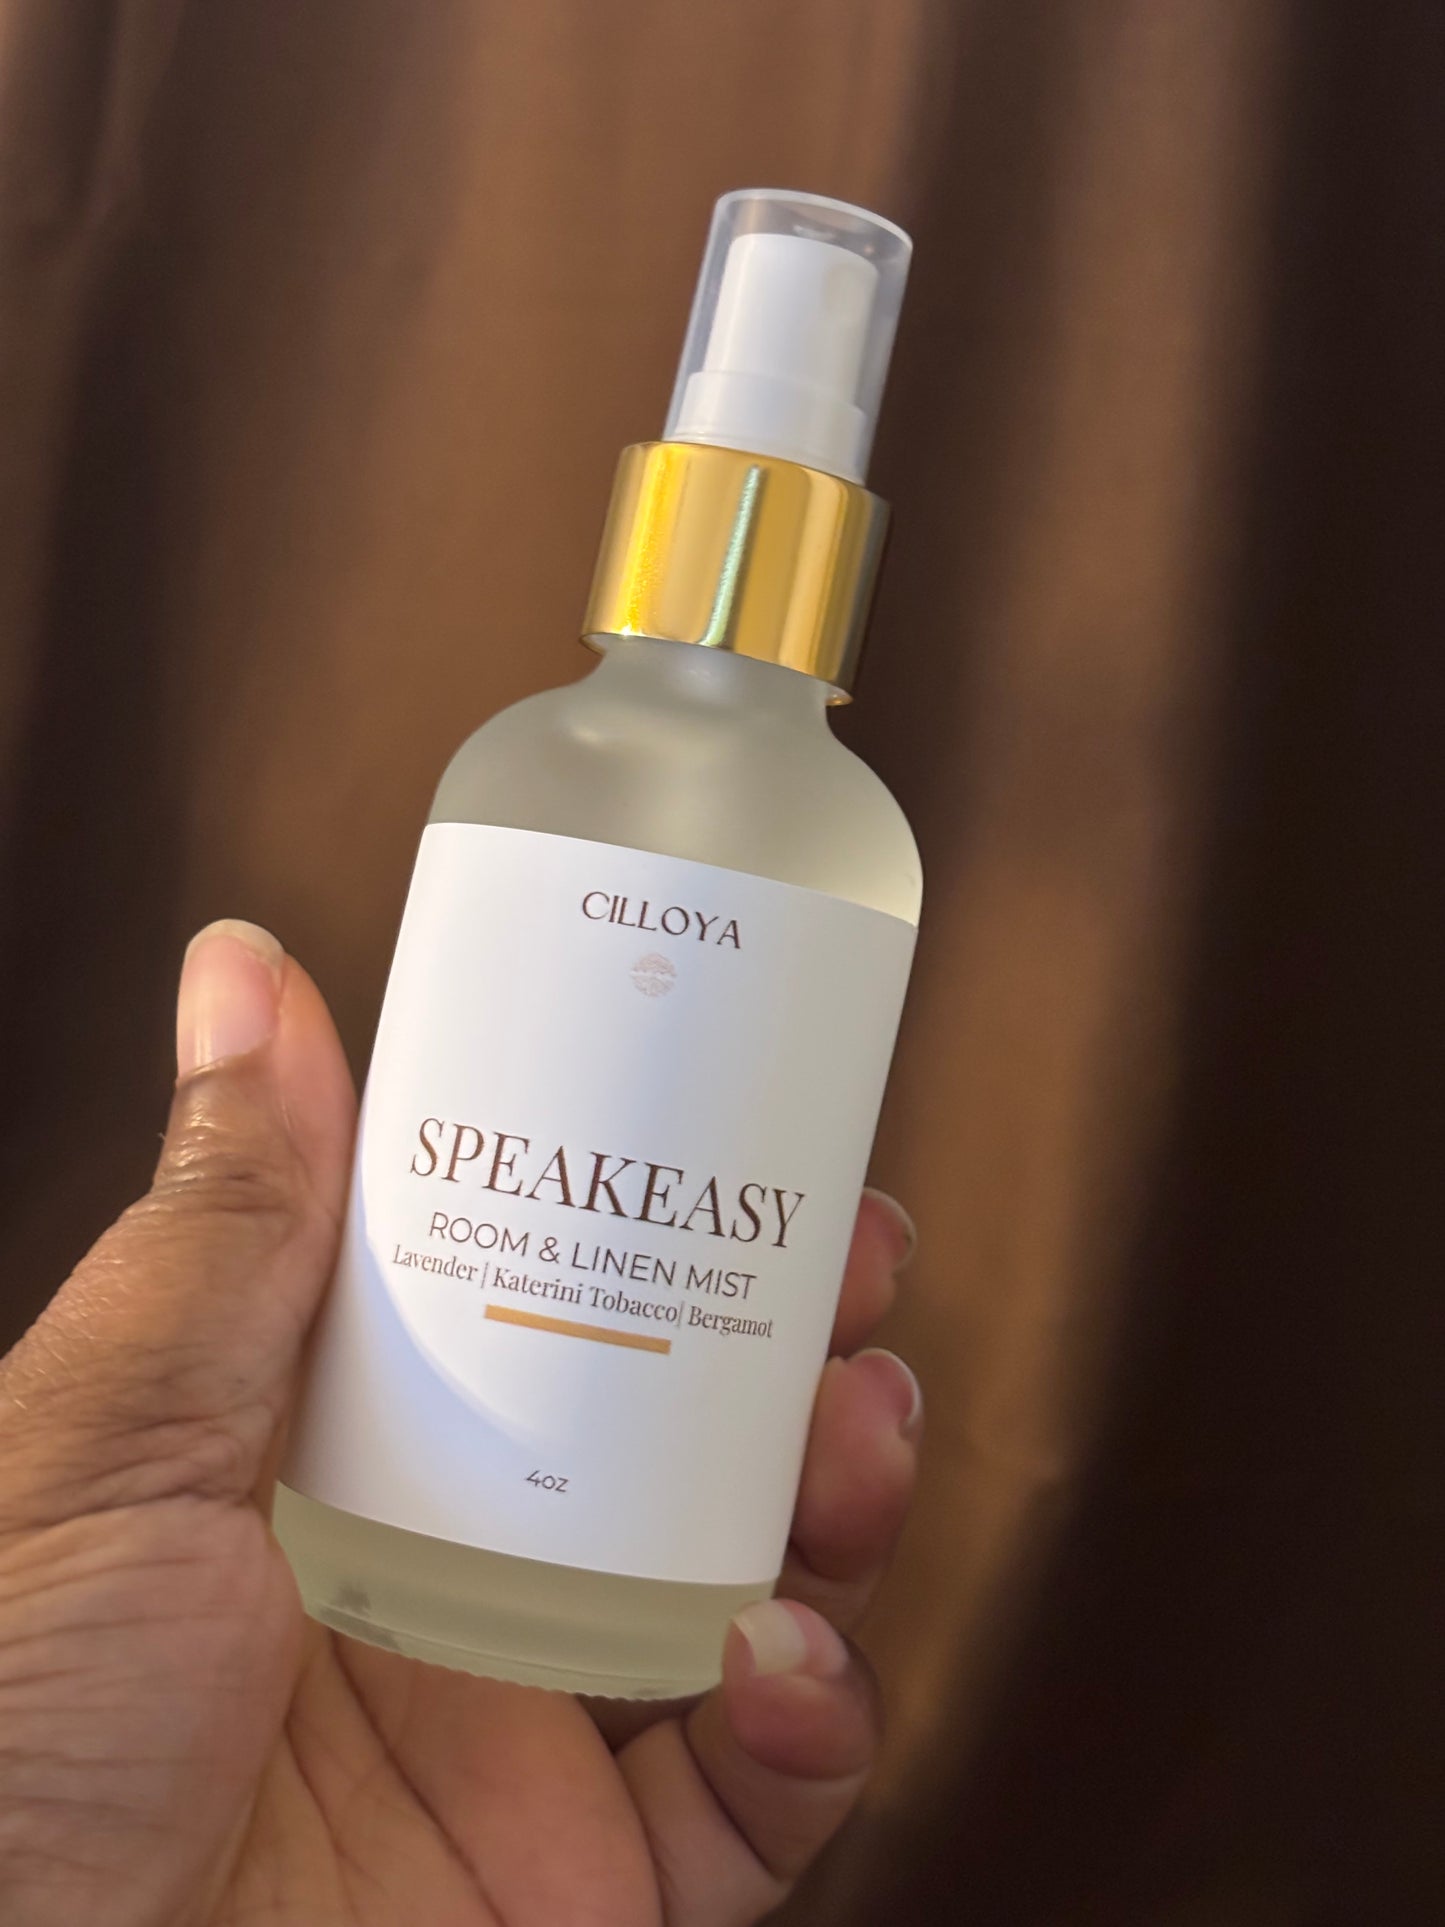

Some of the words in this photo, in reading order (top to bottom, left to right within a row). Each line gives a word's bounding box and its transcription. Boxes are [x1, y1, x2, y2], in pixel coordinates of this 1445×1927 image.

[582, 891, 741, 949] CILLOYA
[409, 1117, 805, 1248] SPEAKEASY
[392, 1244, 478, 1282] Lavender
[492, 1267, 584, 1305] Katerini
[687, 1305, 773, 1339] Bergamot
[428, 1211, 531, 1257] ROOM
[538, 1236, 560, 1264] &
[571, 1242, 676, 1286] LINEN
[685, 1264, 757, 1300] MIST
